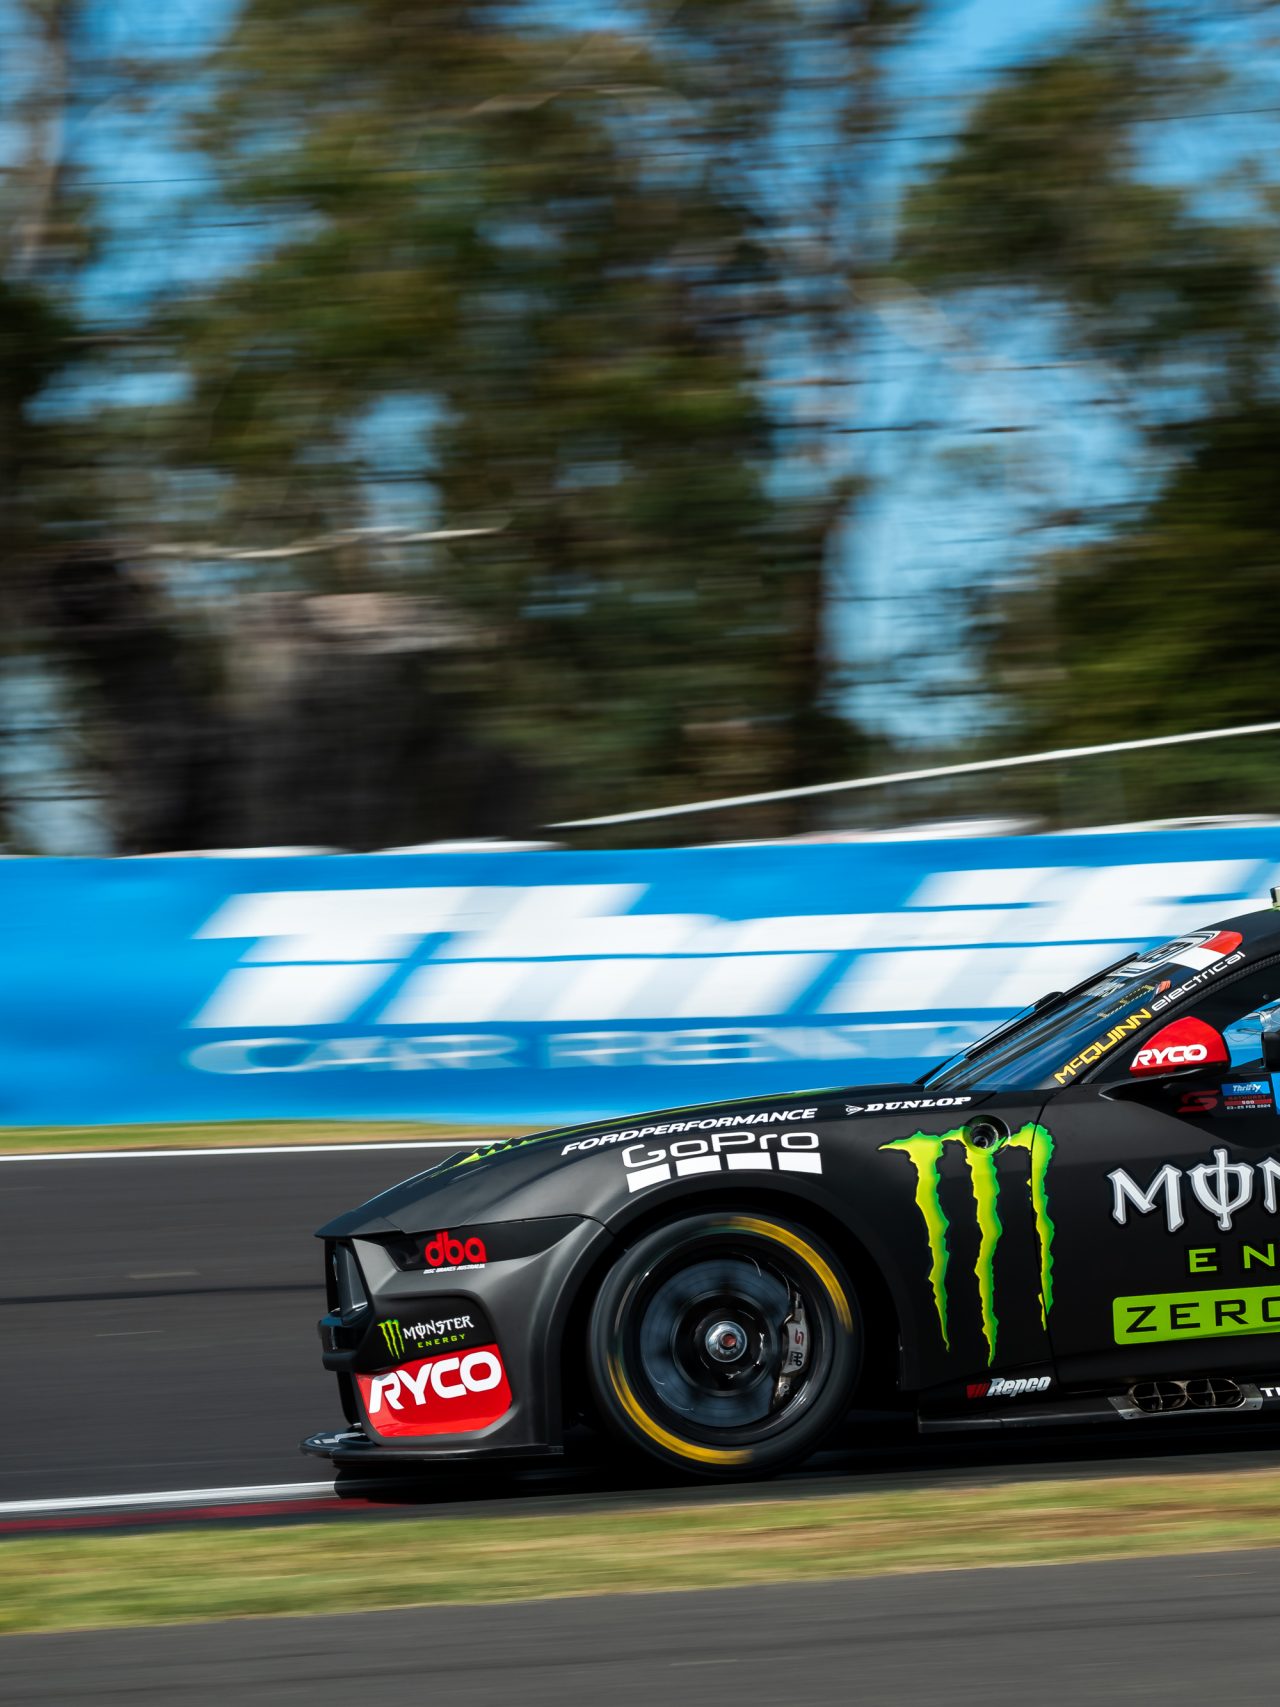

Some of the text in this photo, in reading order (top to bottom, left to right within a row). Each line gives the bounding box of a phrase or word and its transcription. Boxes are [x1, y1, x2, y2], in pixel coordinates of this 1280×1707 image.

[1151, 950, 1247, 1012] electrical
[1132, 1043, 1208, 1069] RYCO
[1232, 1083, 1262, 1093] Thrifty
[864, 1096, 972, 1112] DUNLOP
[621, 1131, 820, 1169] GoPro
[425, 1231, 487, 1268] dba
[402, 1315, 475, 1341] MONSTER
[417, 1333, 466, 1348] ENERGY
[368, 1351, 503, 1415] RYCO
[987, 1376, 1051, 1398] Repco
